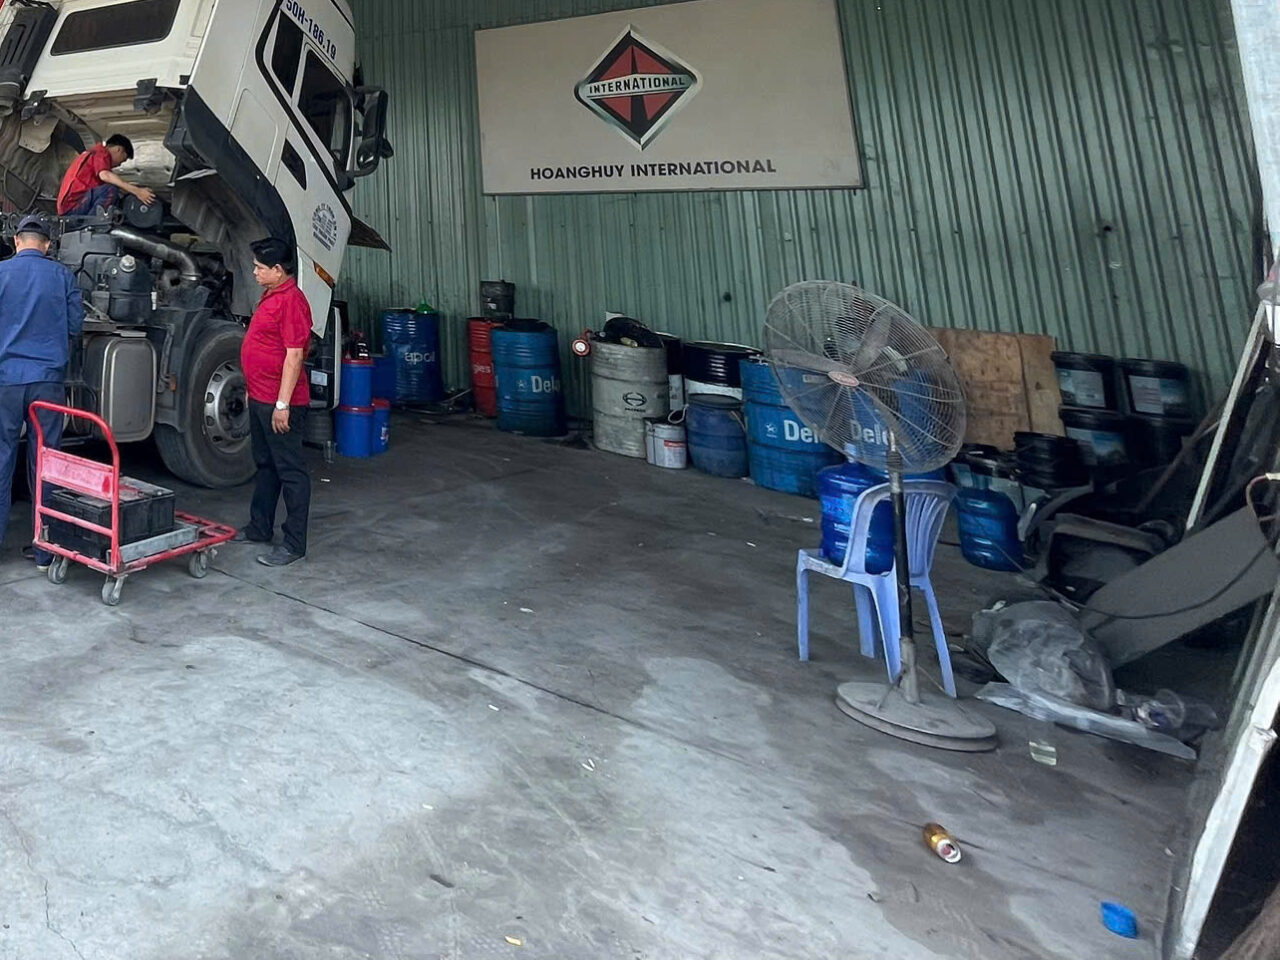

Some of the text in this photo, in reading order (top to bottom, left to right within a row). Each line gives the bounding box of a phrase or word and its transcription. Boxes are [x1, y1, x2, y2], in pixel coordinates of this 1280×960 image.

[589, 77, 686, 94] INTERNATIONAL
[530, 159, 777, 180] HOANGHUY INTERNATIONAL
